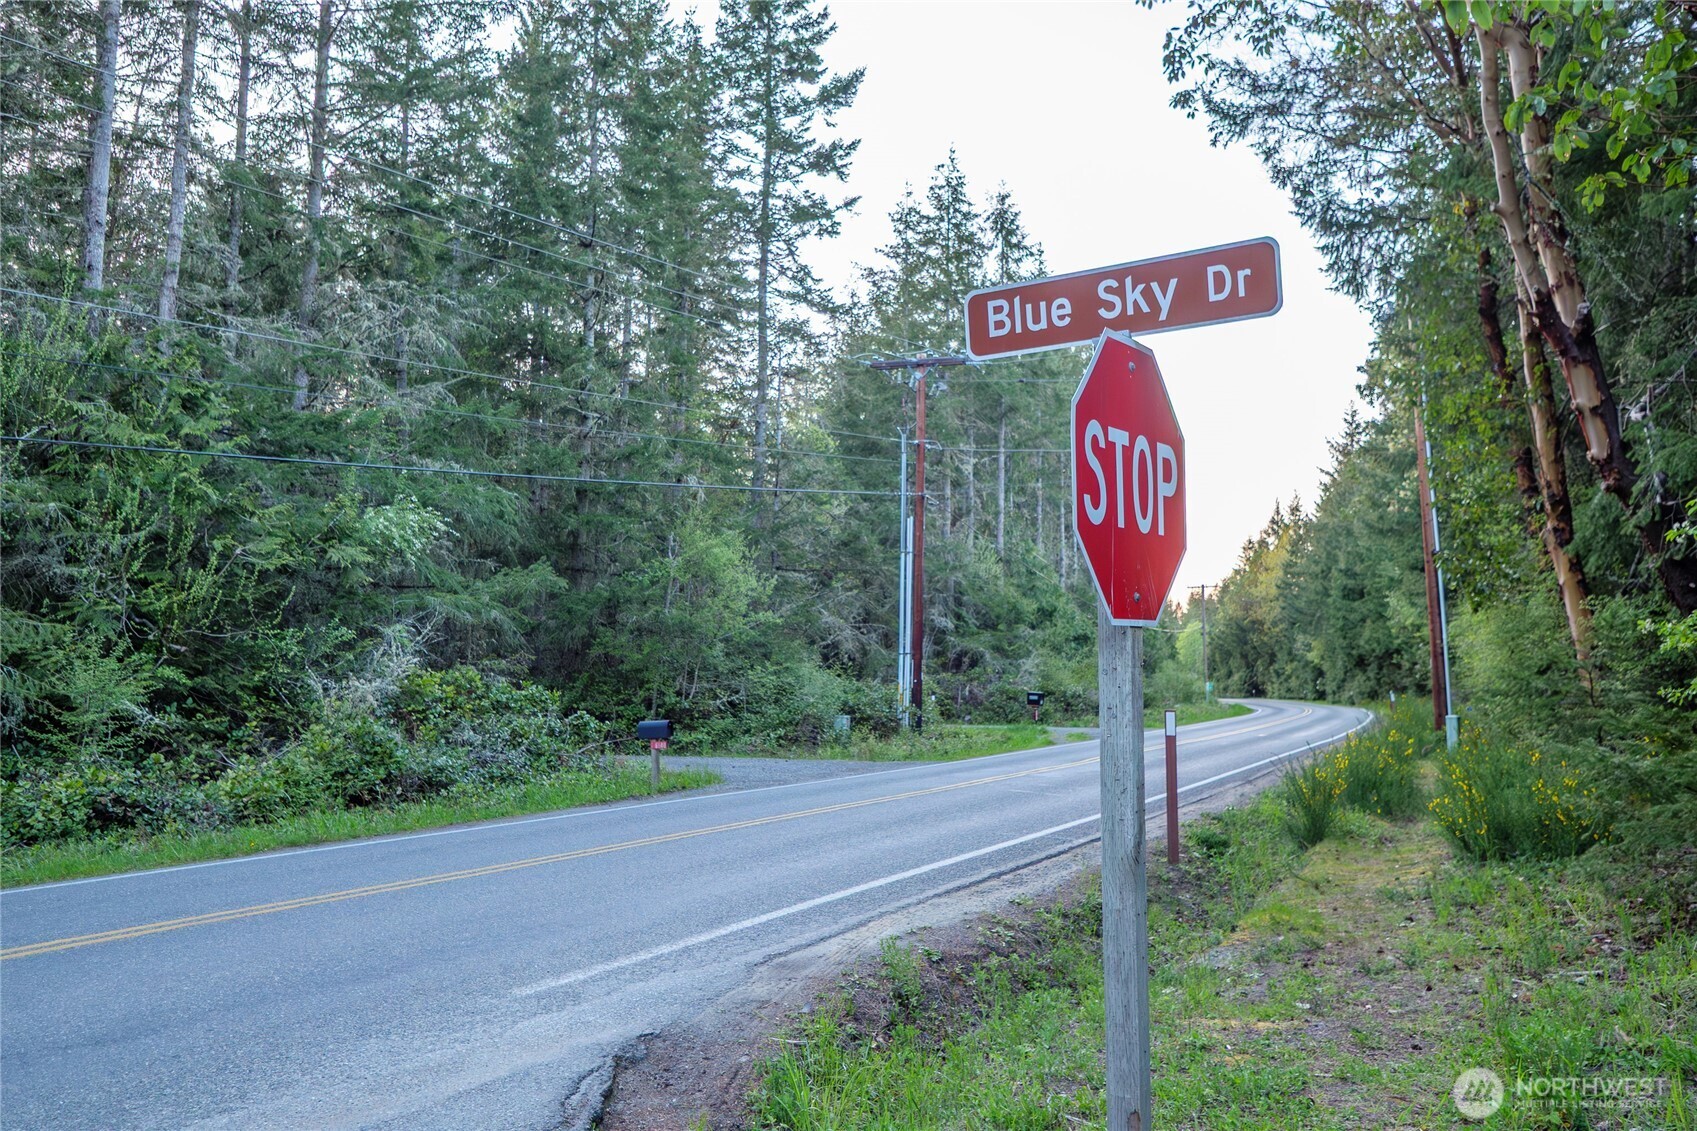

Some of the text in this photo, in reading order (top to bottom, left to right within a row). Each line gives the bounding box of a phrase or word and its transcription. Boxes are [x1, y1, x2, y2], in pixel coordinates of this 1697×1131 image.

[987, 264, 1251, 338] Blue Sky Dr
[1083, 419, 1178, 536] STOP
